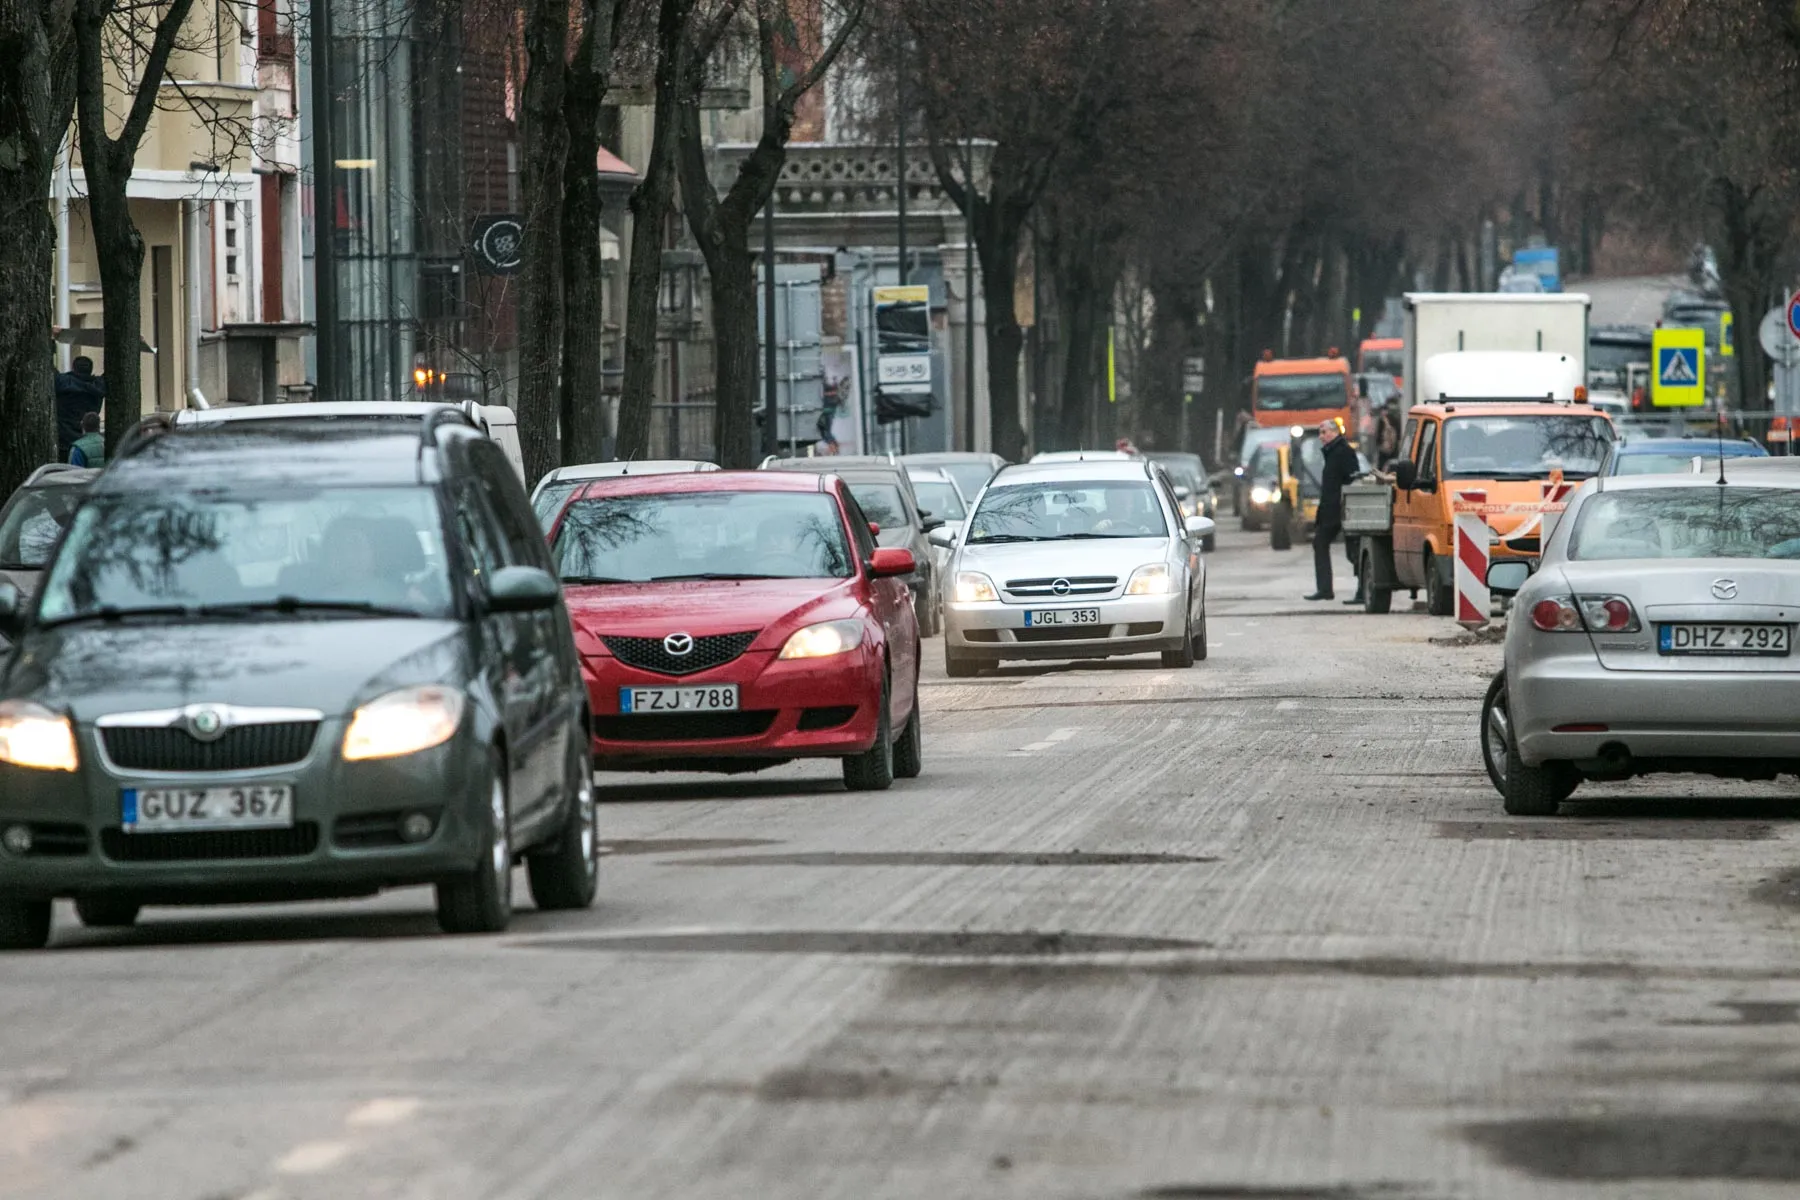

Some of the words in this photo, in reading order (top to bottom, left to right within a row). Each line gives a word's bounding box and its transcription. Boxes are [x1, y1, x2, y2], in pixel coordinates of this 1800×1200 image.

[1033, 612, 1063, 624] JGL
[1072, 610, 1097, 623] 353
[1674, 627, 1726, 648] DHZ
[1742, 627, 1784, 649] 292
[634, 690, 680, 710] FZJ
[694, 689, 734, 708] 788
[141, 790, 207, 819] GUZ
[229, 789, 285, 818] 367
